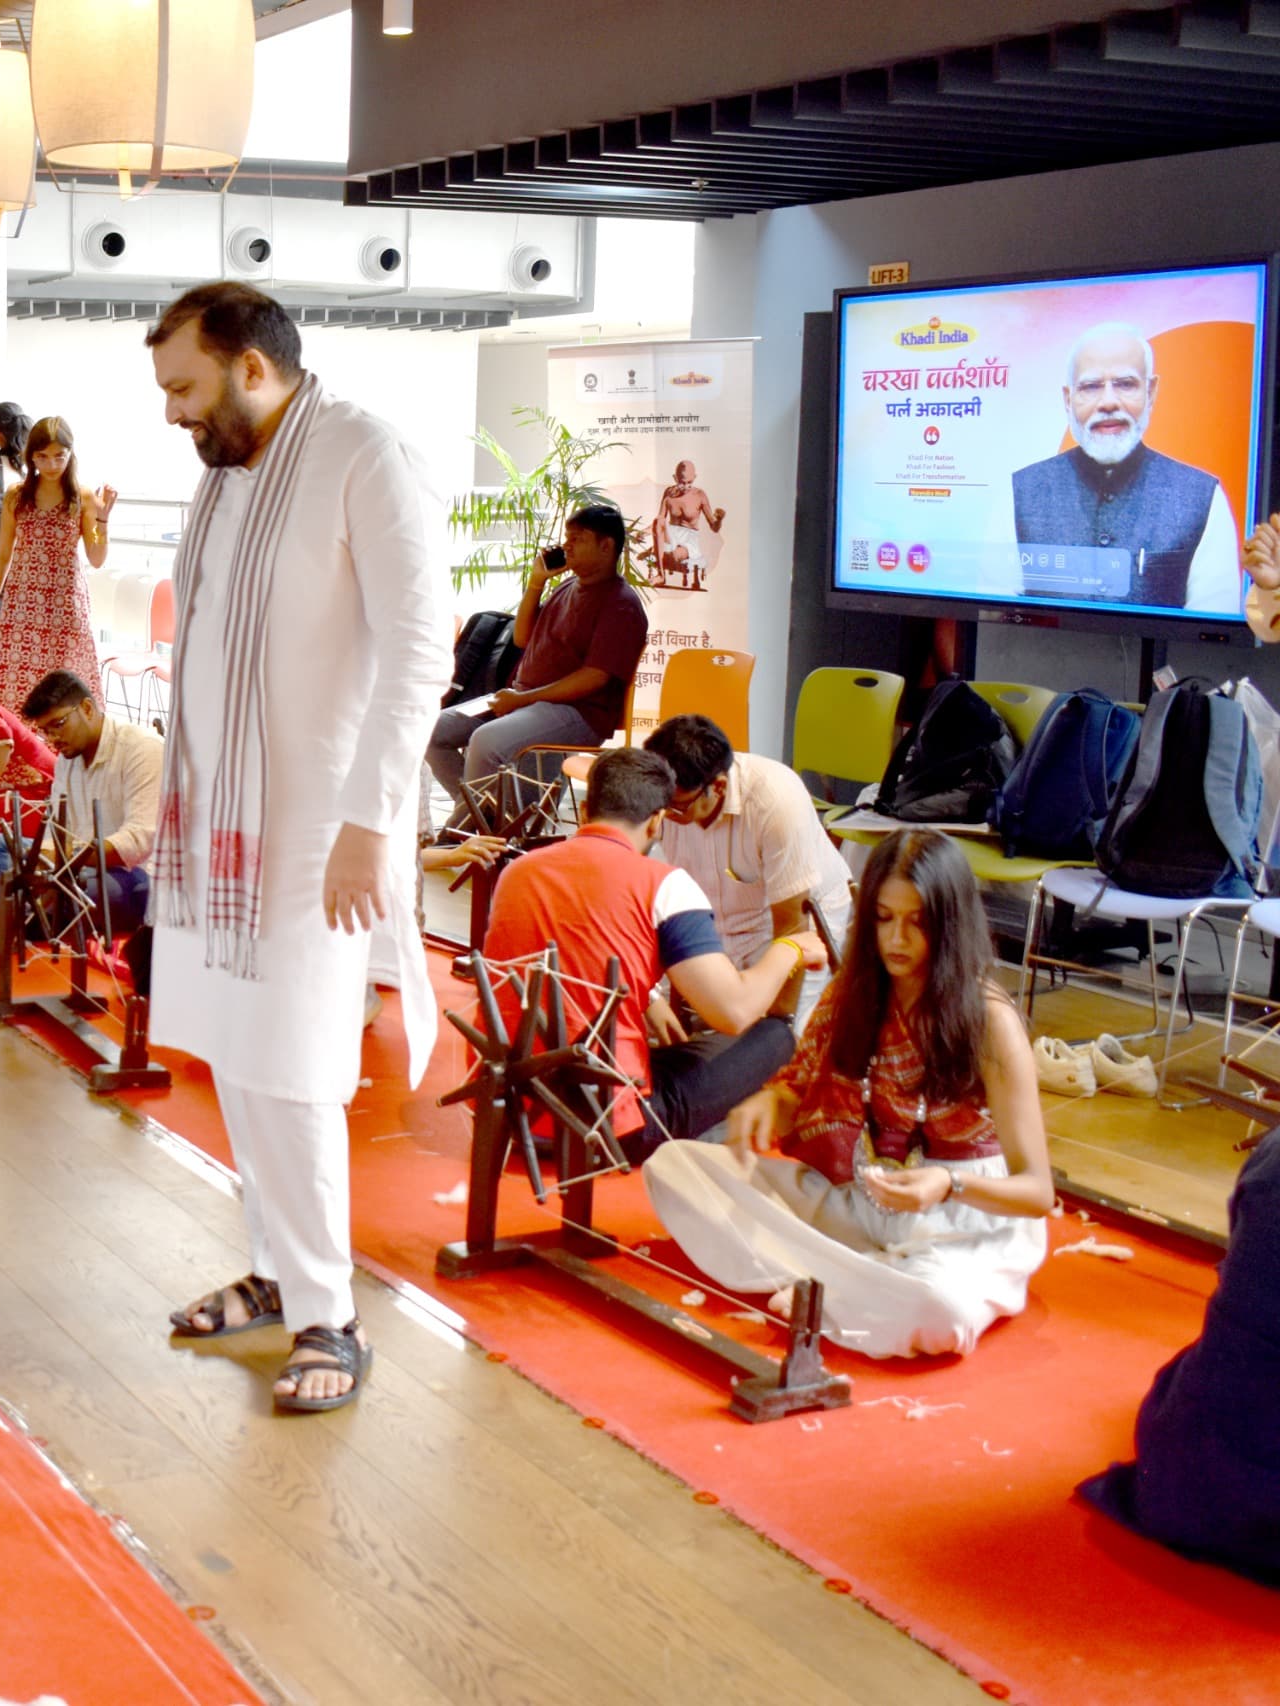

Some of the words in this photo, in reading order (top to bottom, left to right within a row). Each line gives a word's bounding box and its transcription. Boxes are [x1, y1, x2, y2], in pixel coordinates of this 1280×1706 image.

[871, 269, 904, 284] LIFT-3
[900, 331, 935, 346] Khadi
[939, 330, 968, 344] India
[862, 369, 921, 391] चरखा
[926, 357, 1010, 390] वर्कशॉप
[886, 398, 911, 418] पर्ल
[915, 396, 982, 418] अकादमी
[667, 630, 698, 647] विचार
[652, 650, 665, 665] भी
